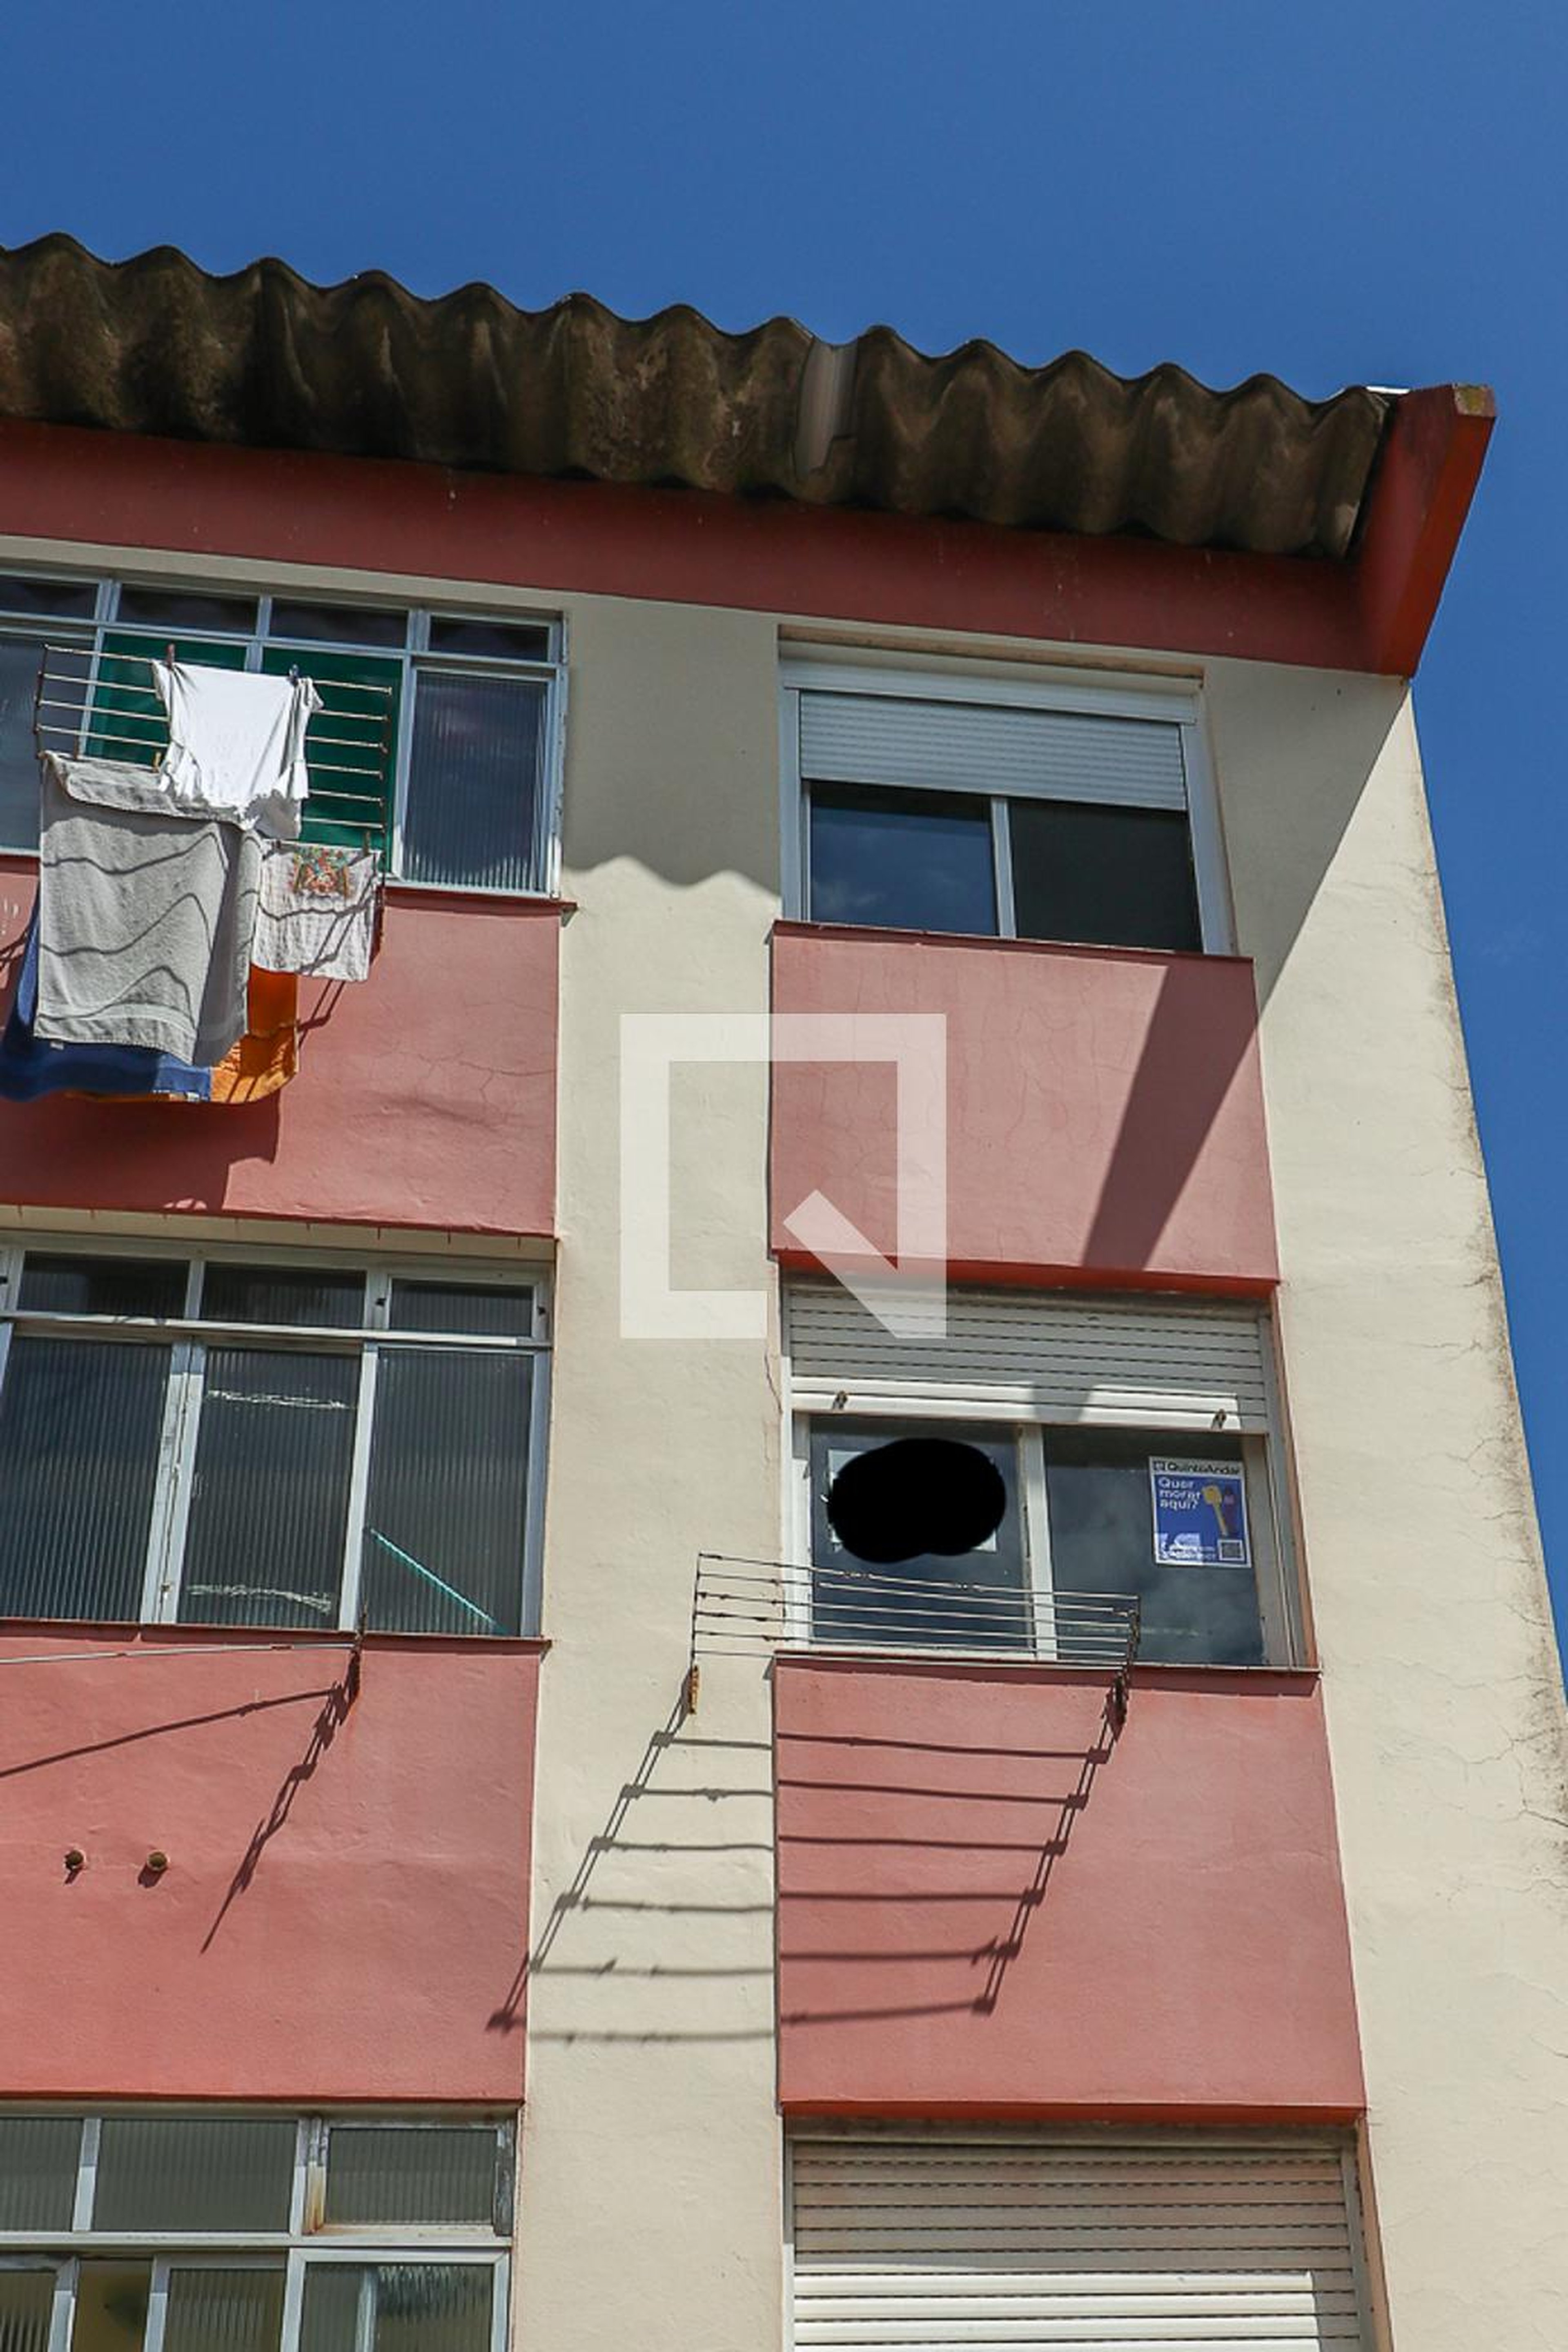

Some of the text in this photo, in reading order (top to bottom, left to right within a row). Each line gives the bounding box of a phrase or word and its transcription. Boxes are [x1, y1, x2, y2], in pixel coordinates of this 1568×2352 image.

[1158, 1477, 1194, 1489] Quer
[1159, 1490, 1200, 1499] morar
[1160, 1498, 1198, 1510] aqui?
